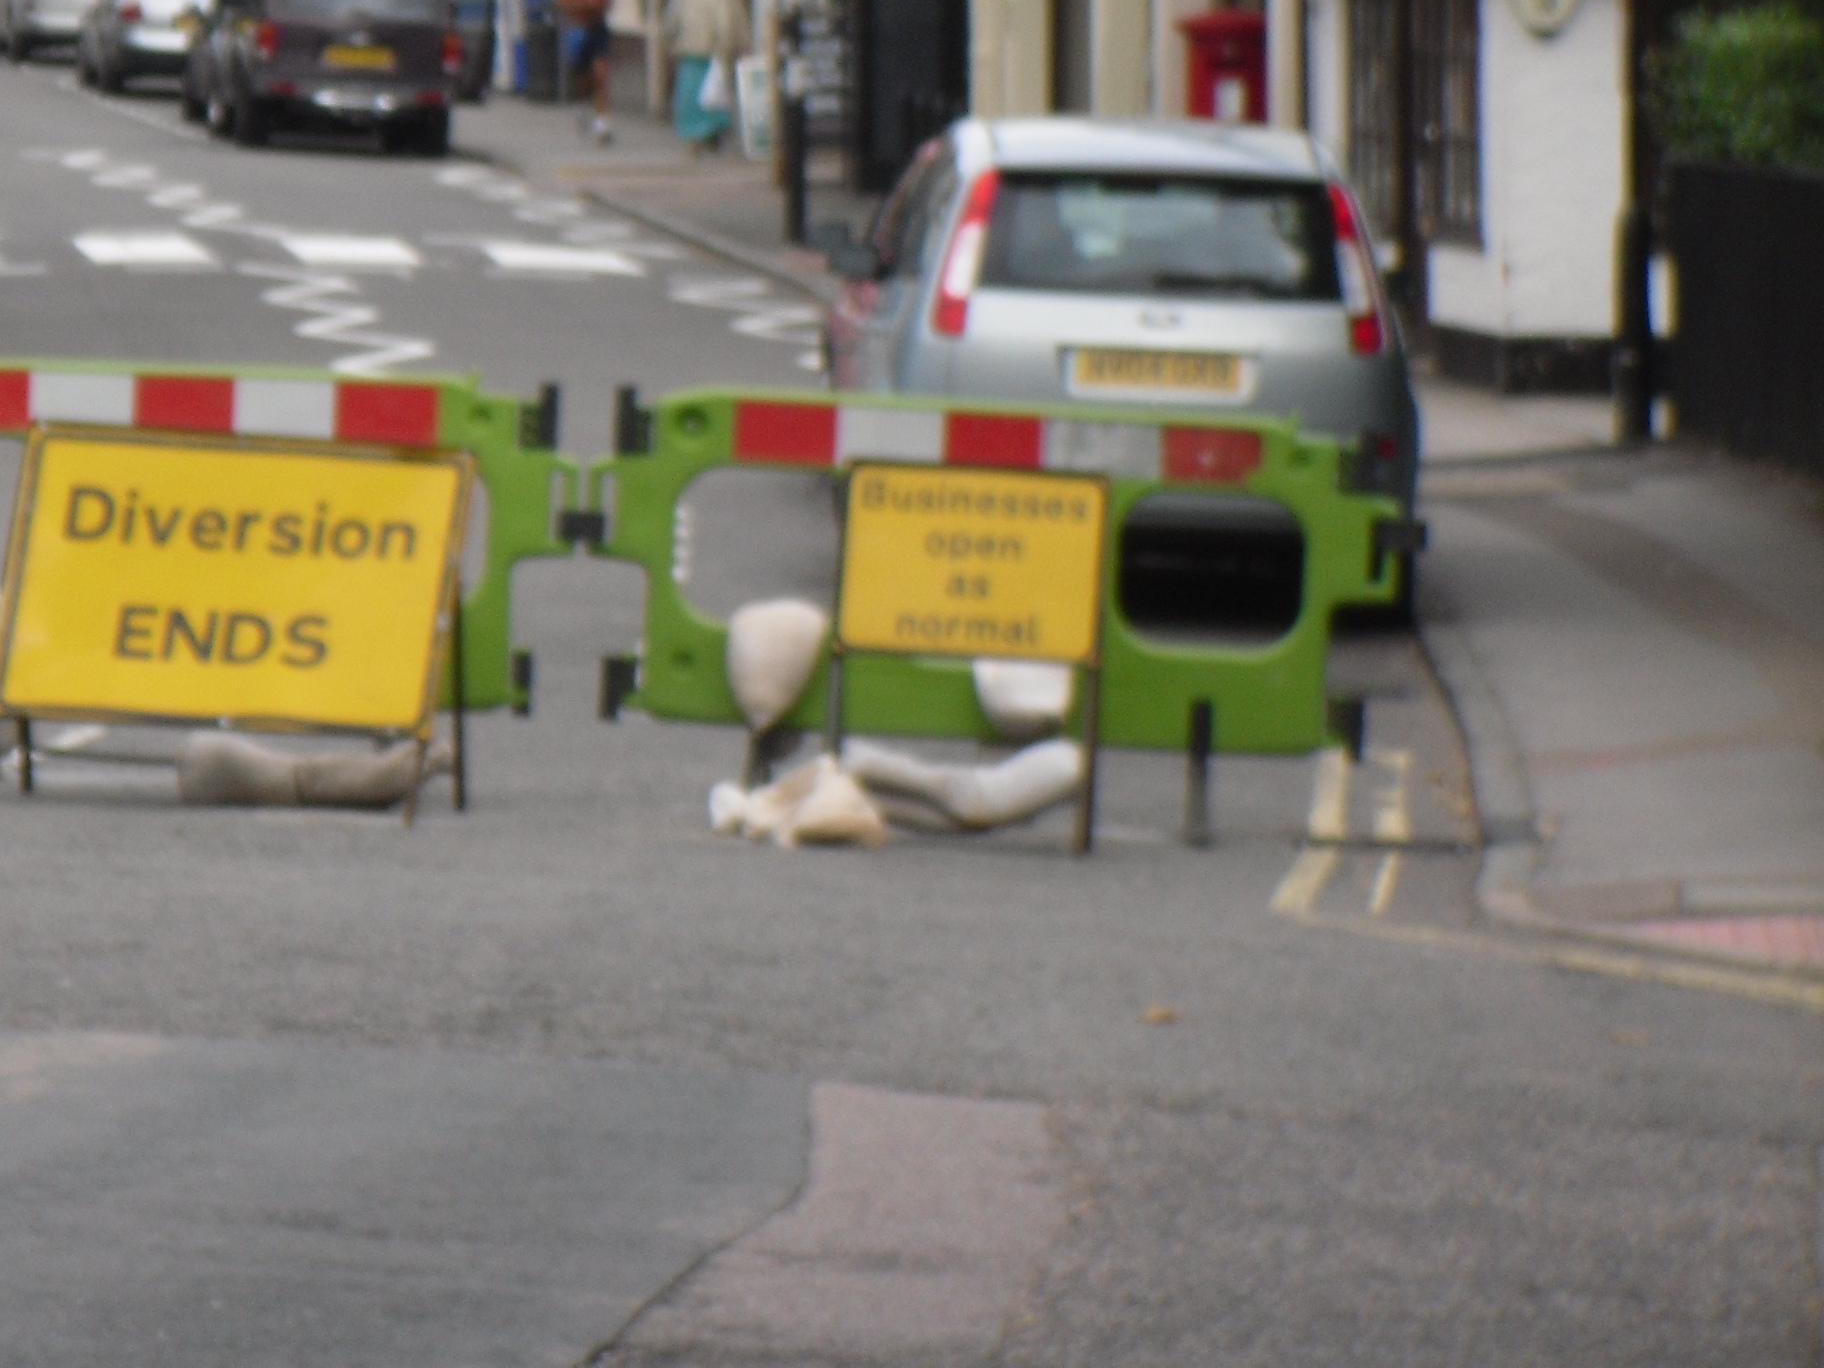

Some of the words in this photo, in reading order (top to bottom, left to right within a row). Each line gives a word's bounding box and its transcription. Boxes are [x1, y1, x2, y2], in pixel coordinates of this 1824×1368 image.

[861, 478, 1089, 522] Businesses
[62, 486, 419, 561] Diversion
[925, 532, 1023, 562] open
[944, 573, 990, 598] as
[113, 604, 331, 669] ENDS
[893, 613, 1039, 646] normal
